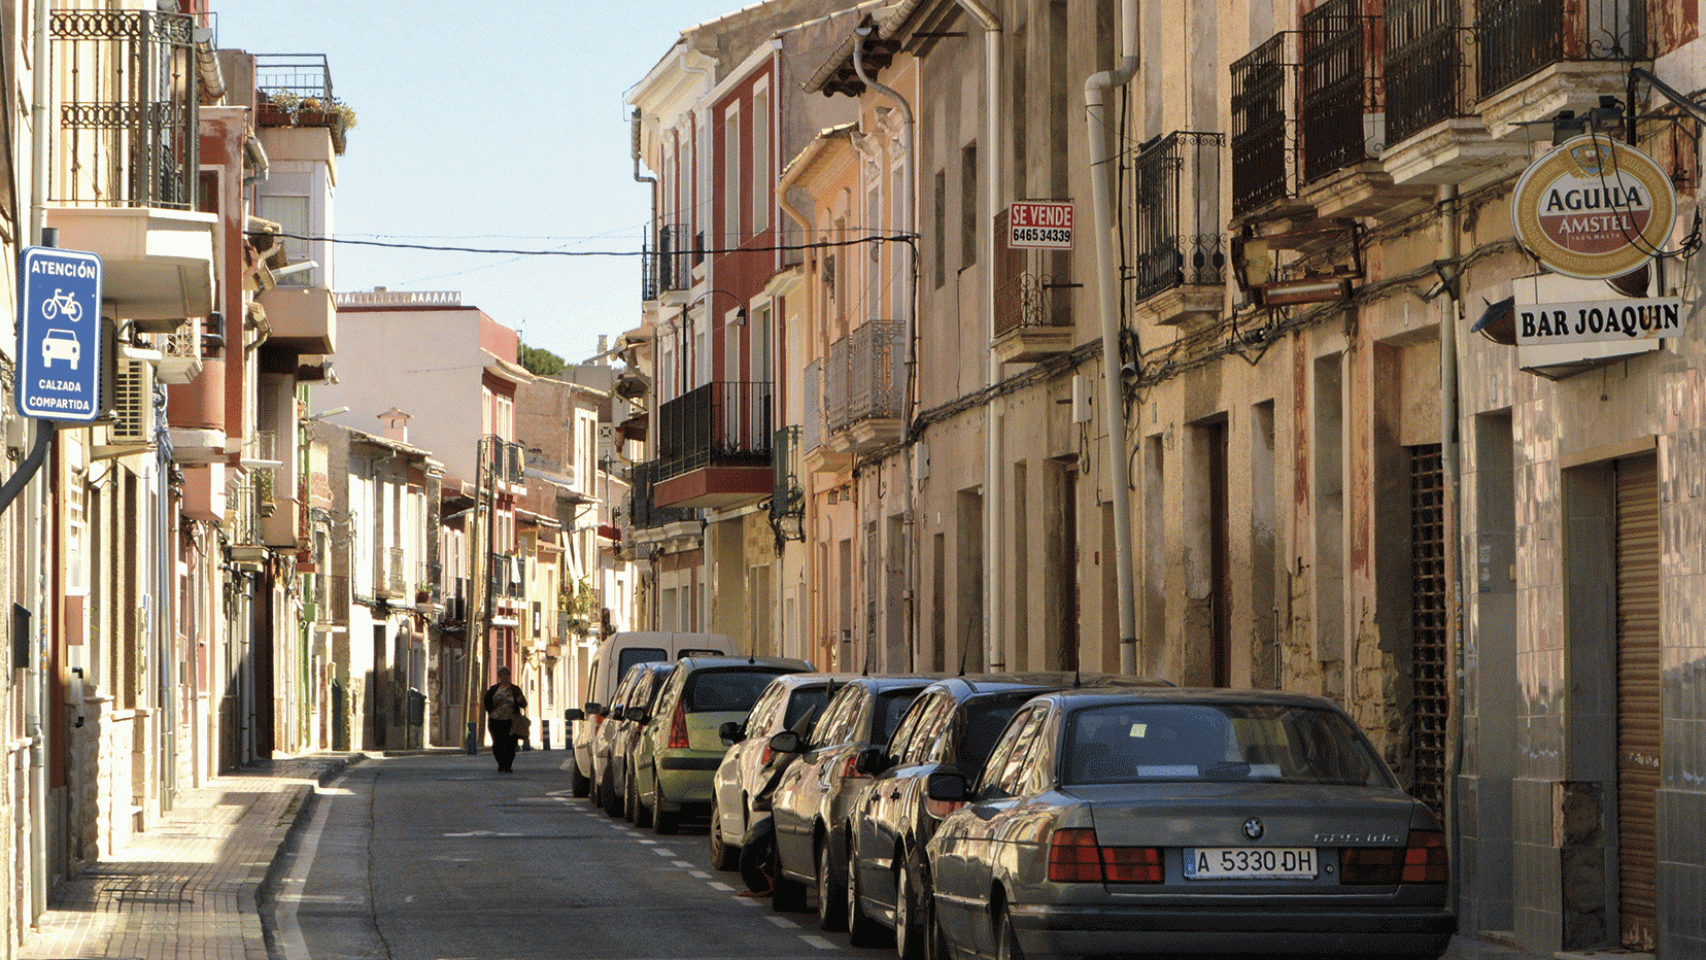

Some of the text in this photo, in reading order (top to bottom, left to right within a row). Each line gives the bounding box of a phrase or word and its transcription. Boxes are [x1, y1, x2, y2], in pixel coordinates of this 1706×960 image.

[1546, 186, 1642, 211] AGUILA
[1013, 205, 1071, 226] SE VENDE
[1558, 215, 1631, 233] AMSTEL
[1594, 232, 1620, 240] MALTA
[31, 261, 95, 279] ATENCIÓN
[1521, 303, 1679, 338] BAR JOAQUIN
[38, 378, 82, 393] CALZADA
[29, 396, 90, 410] COMPARTIDA
[1197, 851, 1311, 871] A 5330 DH
